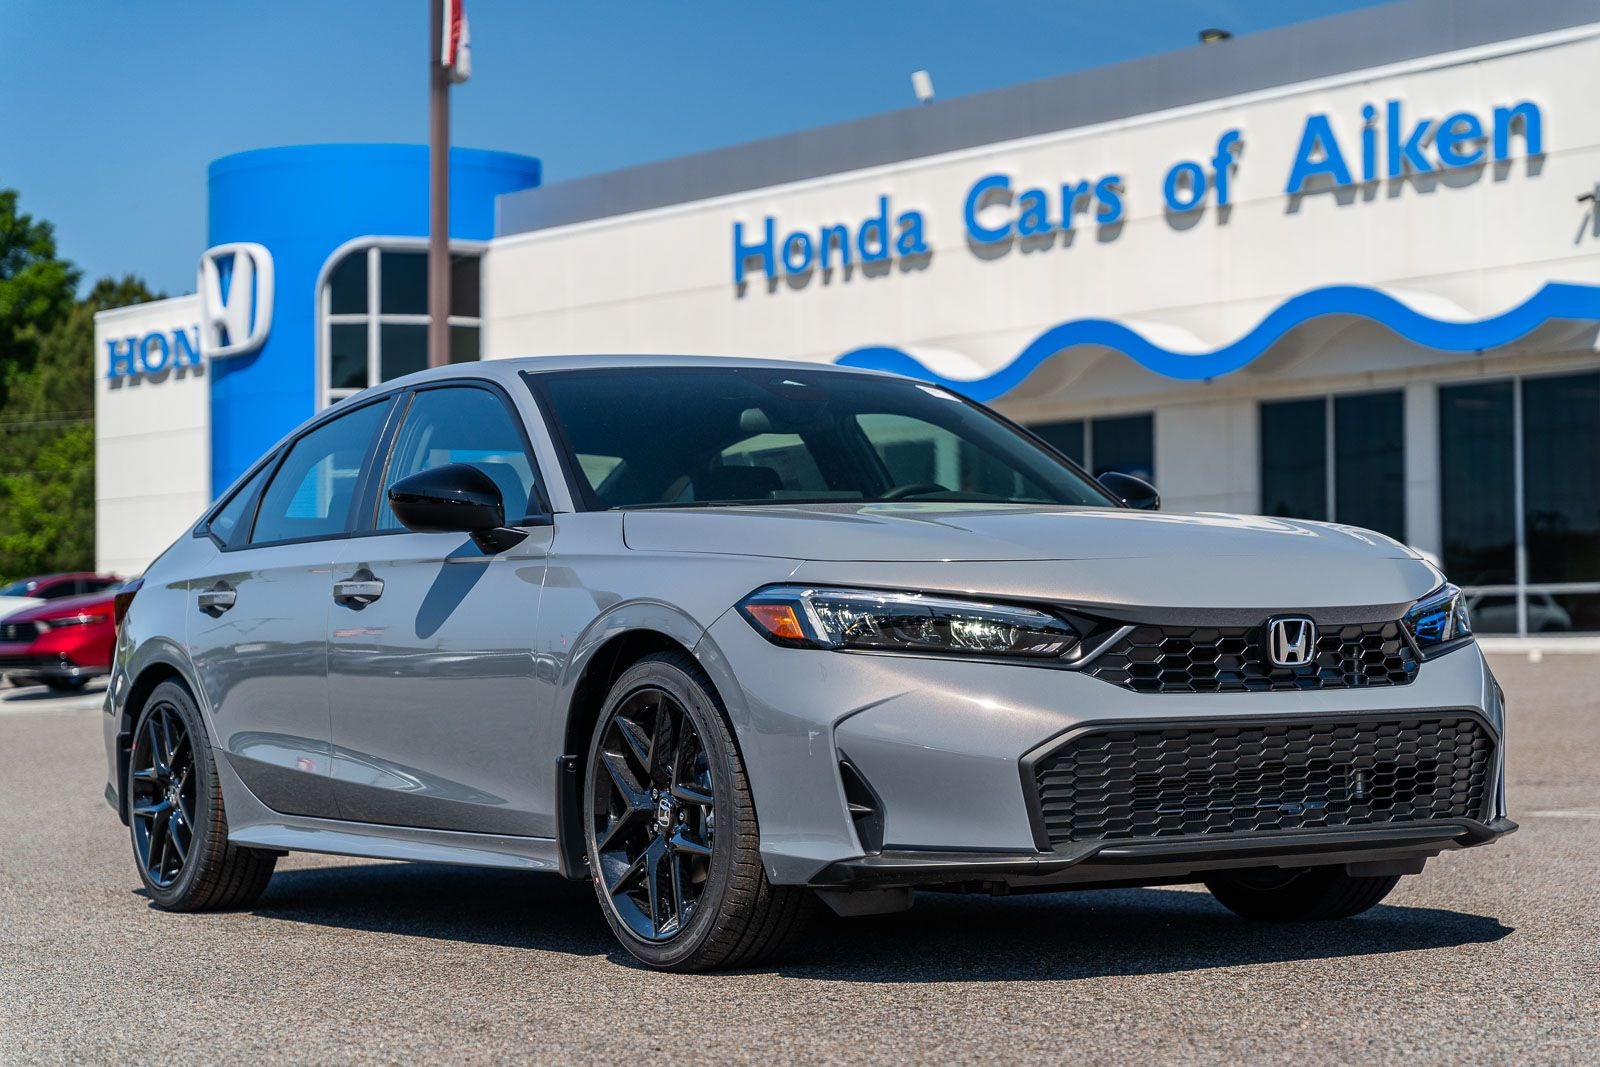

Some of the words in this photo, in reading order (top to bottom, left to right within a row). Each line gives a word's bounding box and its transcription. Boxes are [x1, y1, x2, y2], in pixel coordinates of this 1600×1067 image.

[732, 195, 928, 285] Honda
[963, 173, 1124, 244] Cars
[1162, 128, 1241, 212] of
[1285, 98, 1542, 194] Aiken
